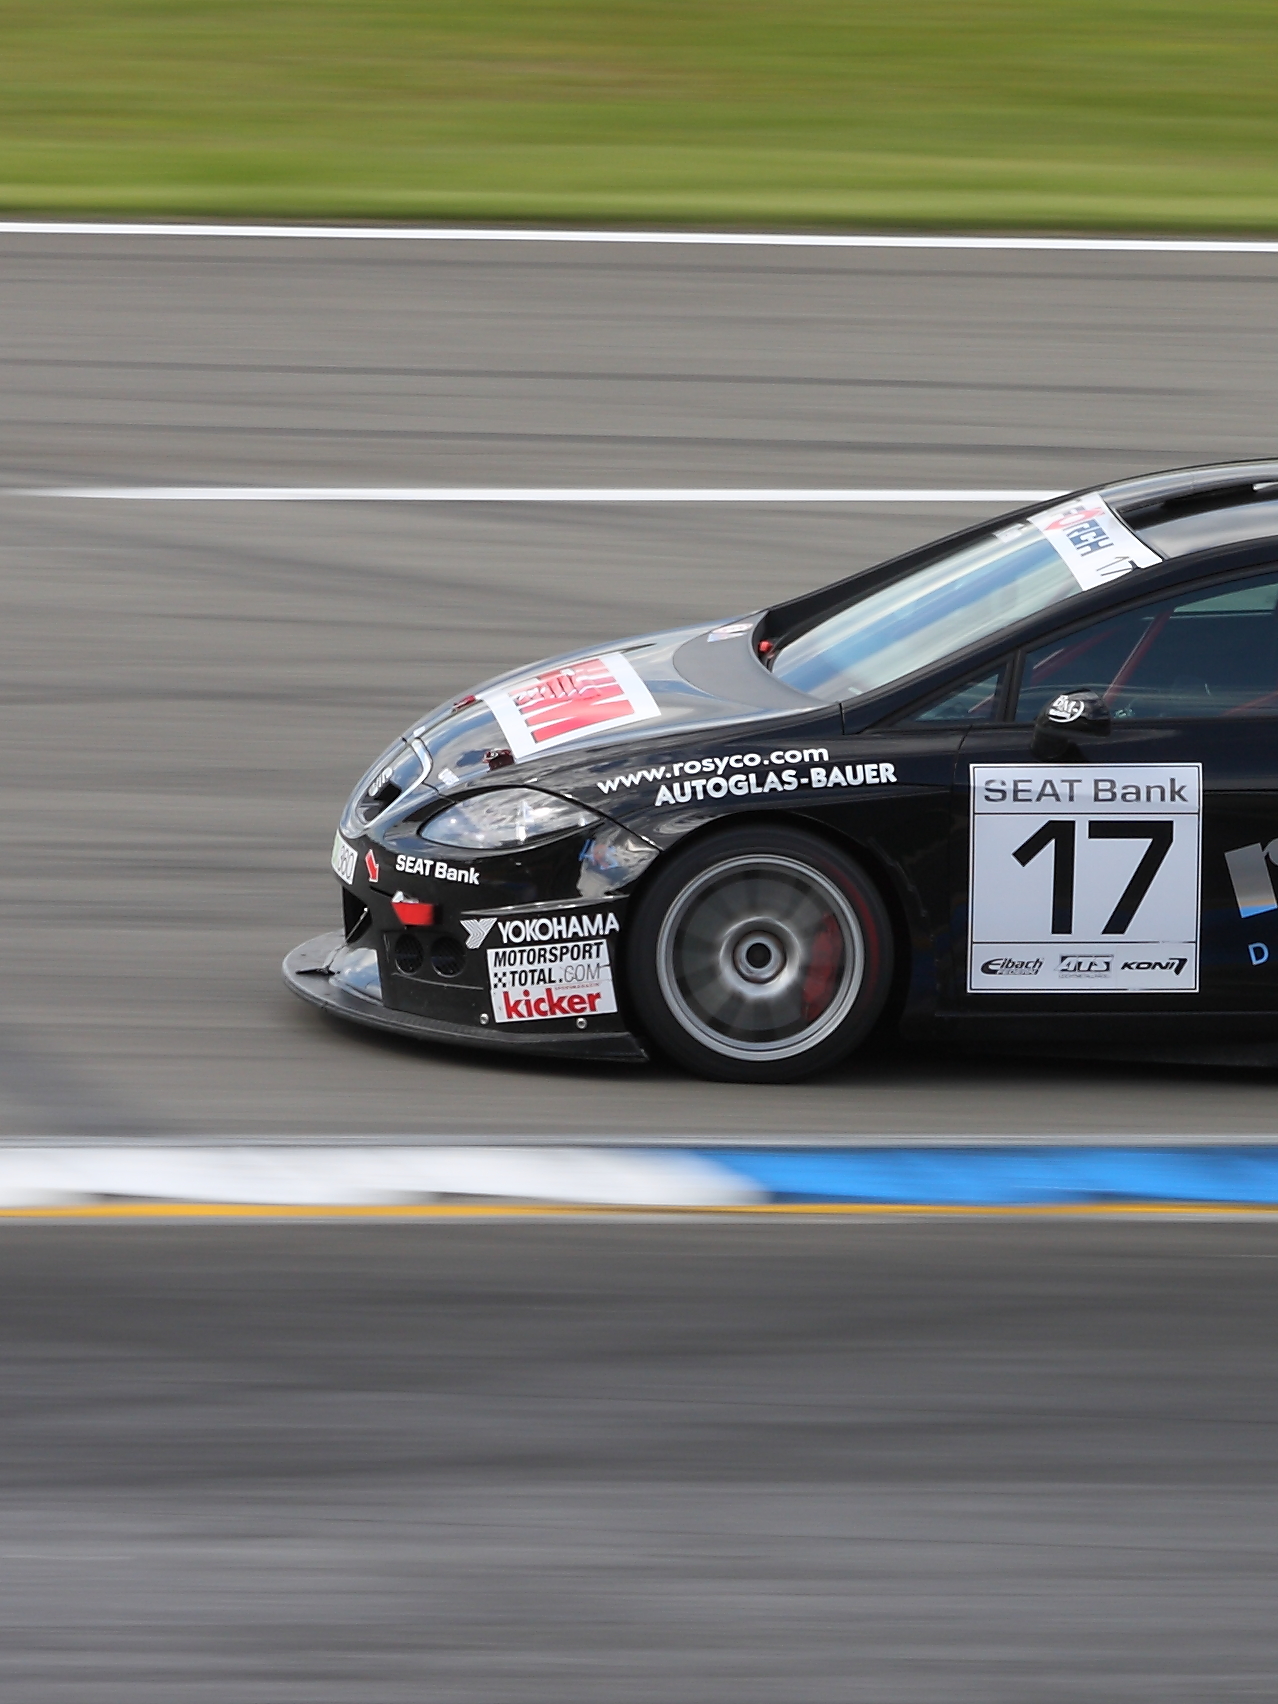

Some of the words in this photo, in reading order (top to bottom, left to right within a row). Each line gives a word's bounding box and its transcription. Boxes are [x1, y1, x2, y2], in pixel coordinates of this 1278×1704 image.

[597, 747, 830, 795] www.rosyco.com
[654, 762, 898, 807] AUTOGLAS-BAUER
[983, 778, 1083, 803] SEAT
[1093, 777, 1189, 803] Bank
[395, 854, 434, 877] SEAT
[435, 860, 480, 885] Bank
[1011, 820, 1175, 935] 17
[497, 912, 620, 944] YOKOHAMA
[493, 941, 604, 968] MOTORSPORT
[980, 957, 1044, 975] Eibach
[502, 987, 602, 1020] kicker
